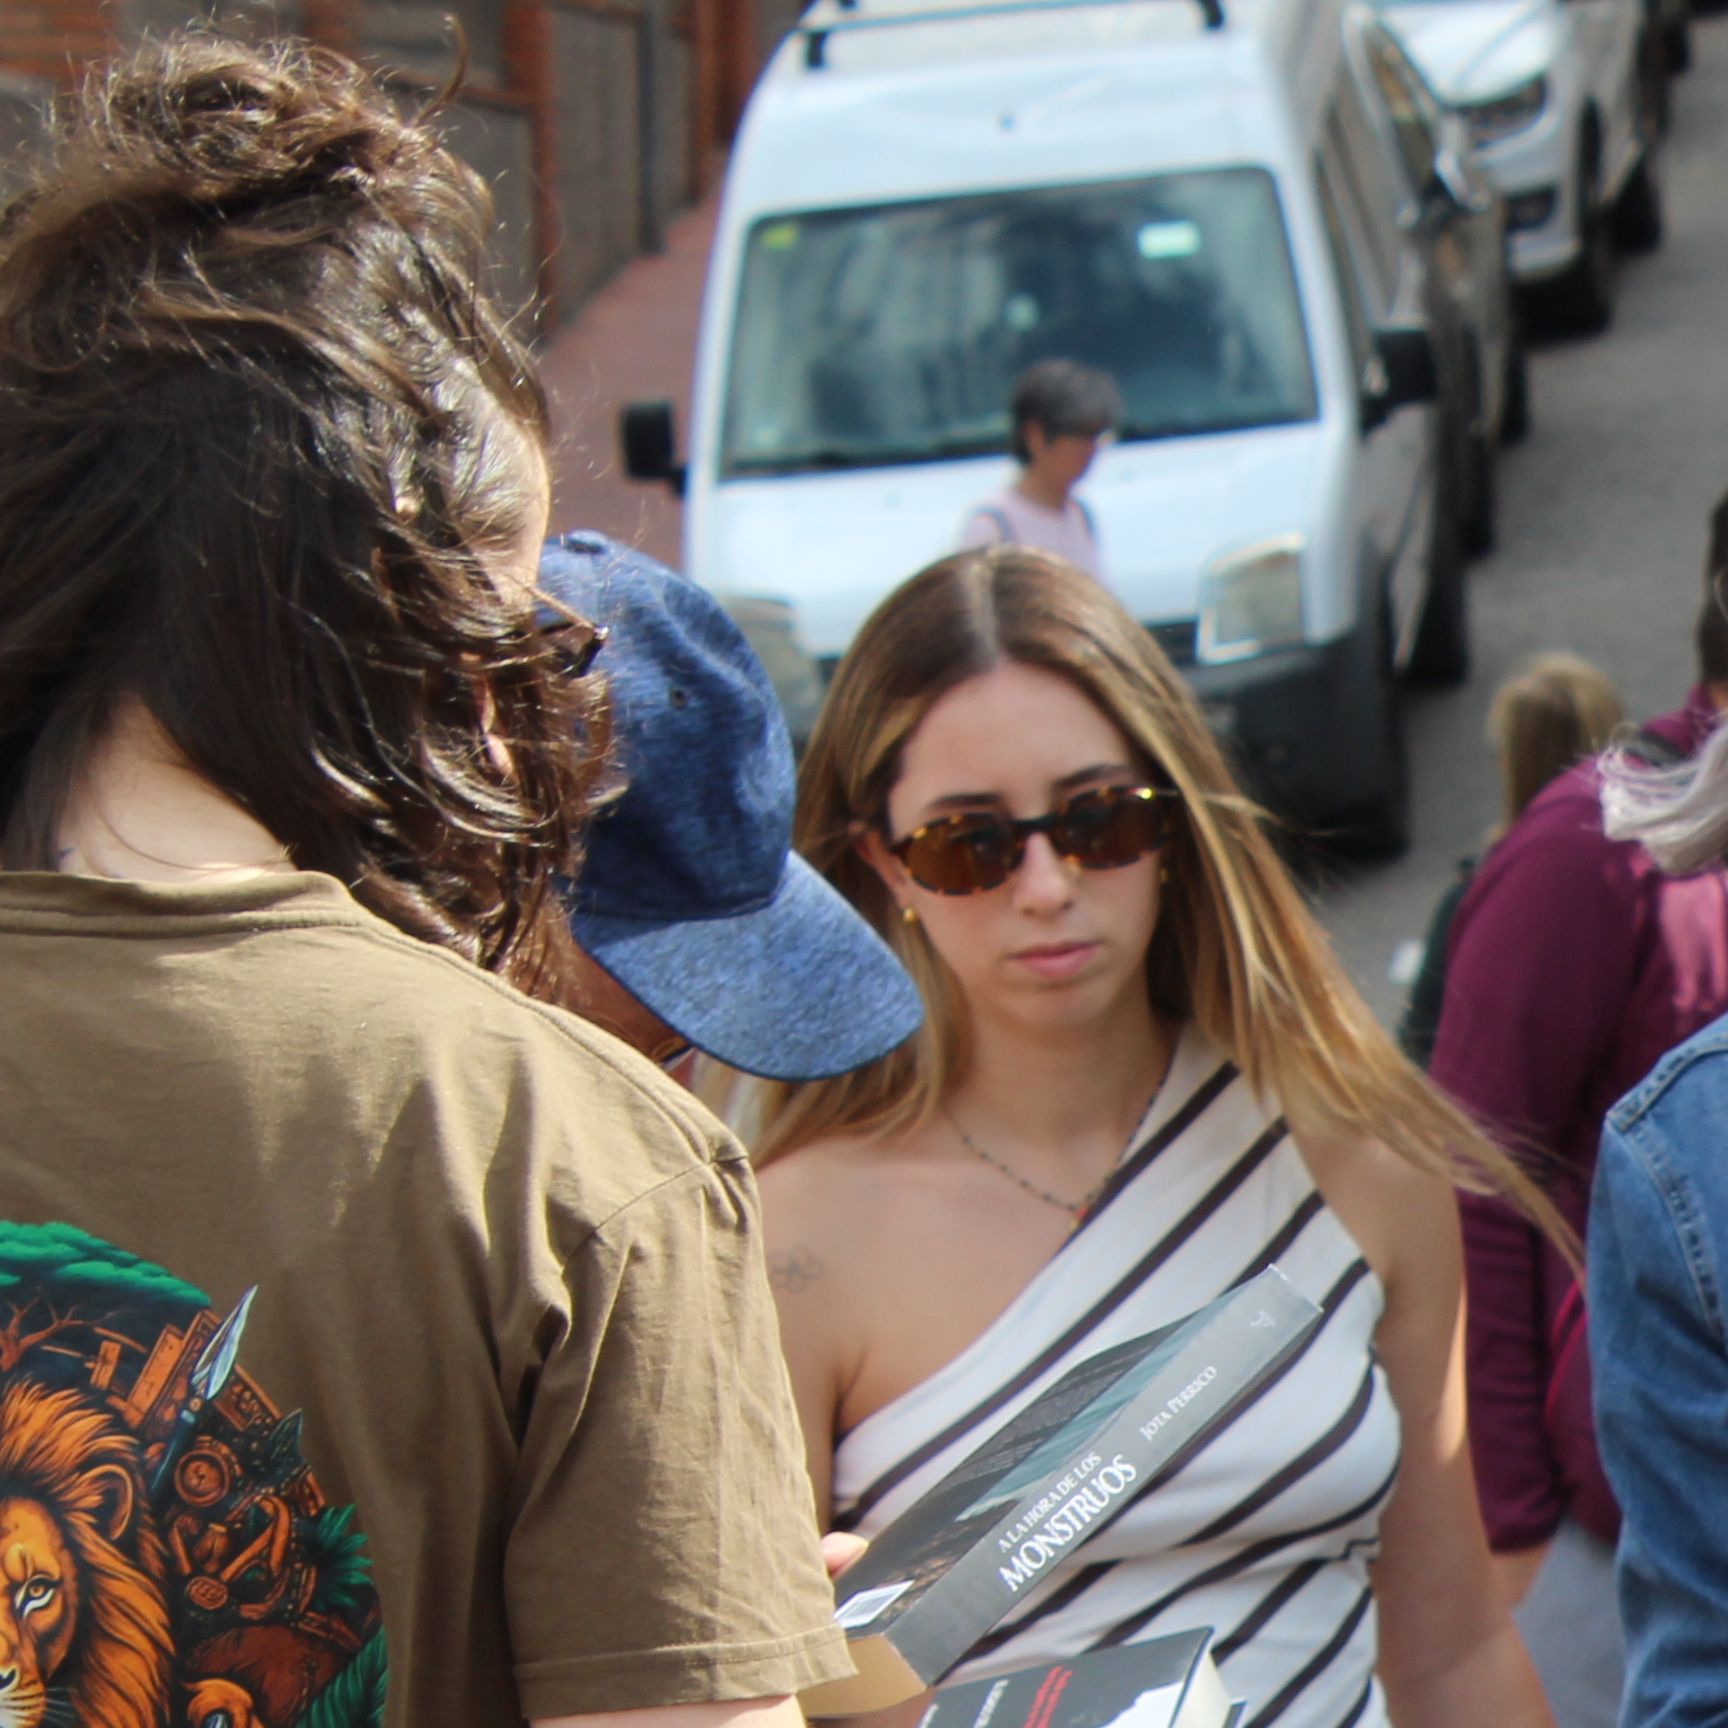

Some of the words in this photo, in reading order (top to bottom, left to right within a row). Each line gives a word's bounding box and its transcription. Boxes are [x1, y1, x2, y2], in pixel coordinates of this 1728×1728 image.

[1140, 1410, 1172, 1441] JOTA
[998, 1539, 1012, 1553] A
[1006, 1522, 1029, 1544] LA
[1023, 1490, 1062, 1527] HORA
[1056, 1473, 1078, 1497] DE
[1073, 1452, 1103, 1481] LOS
[999, 1453, 1137, 1593] MONSTRUOS
